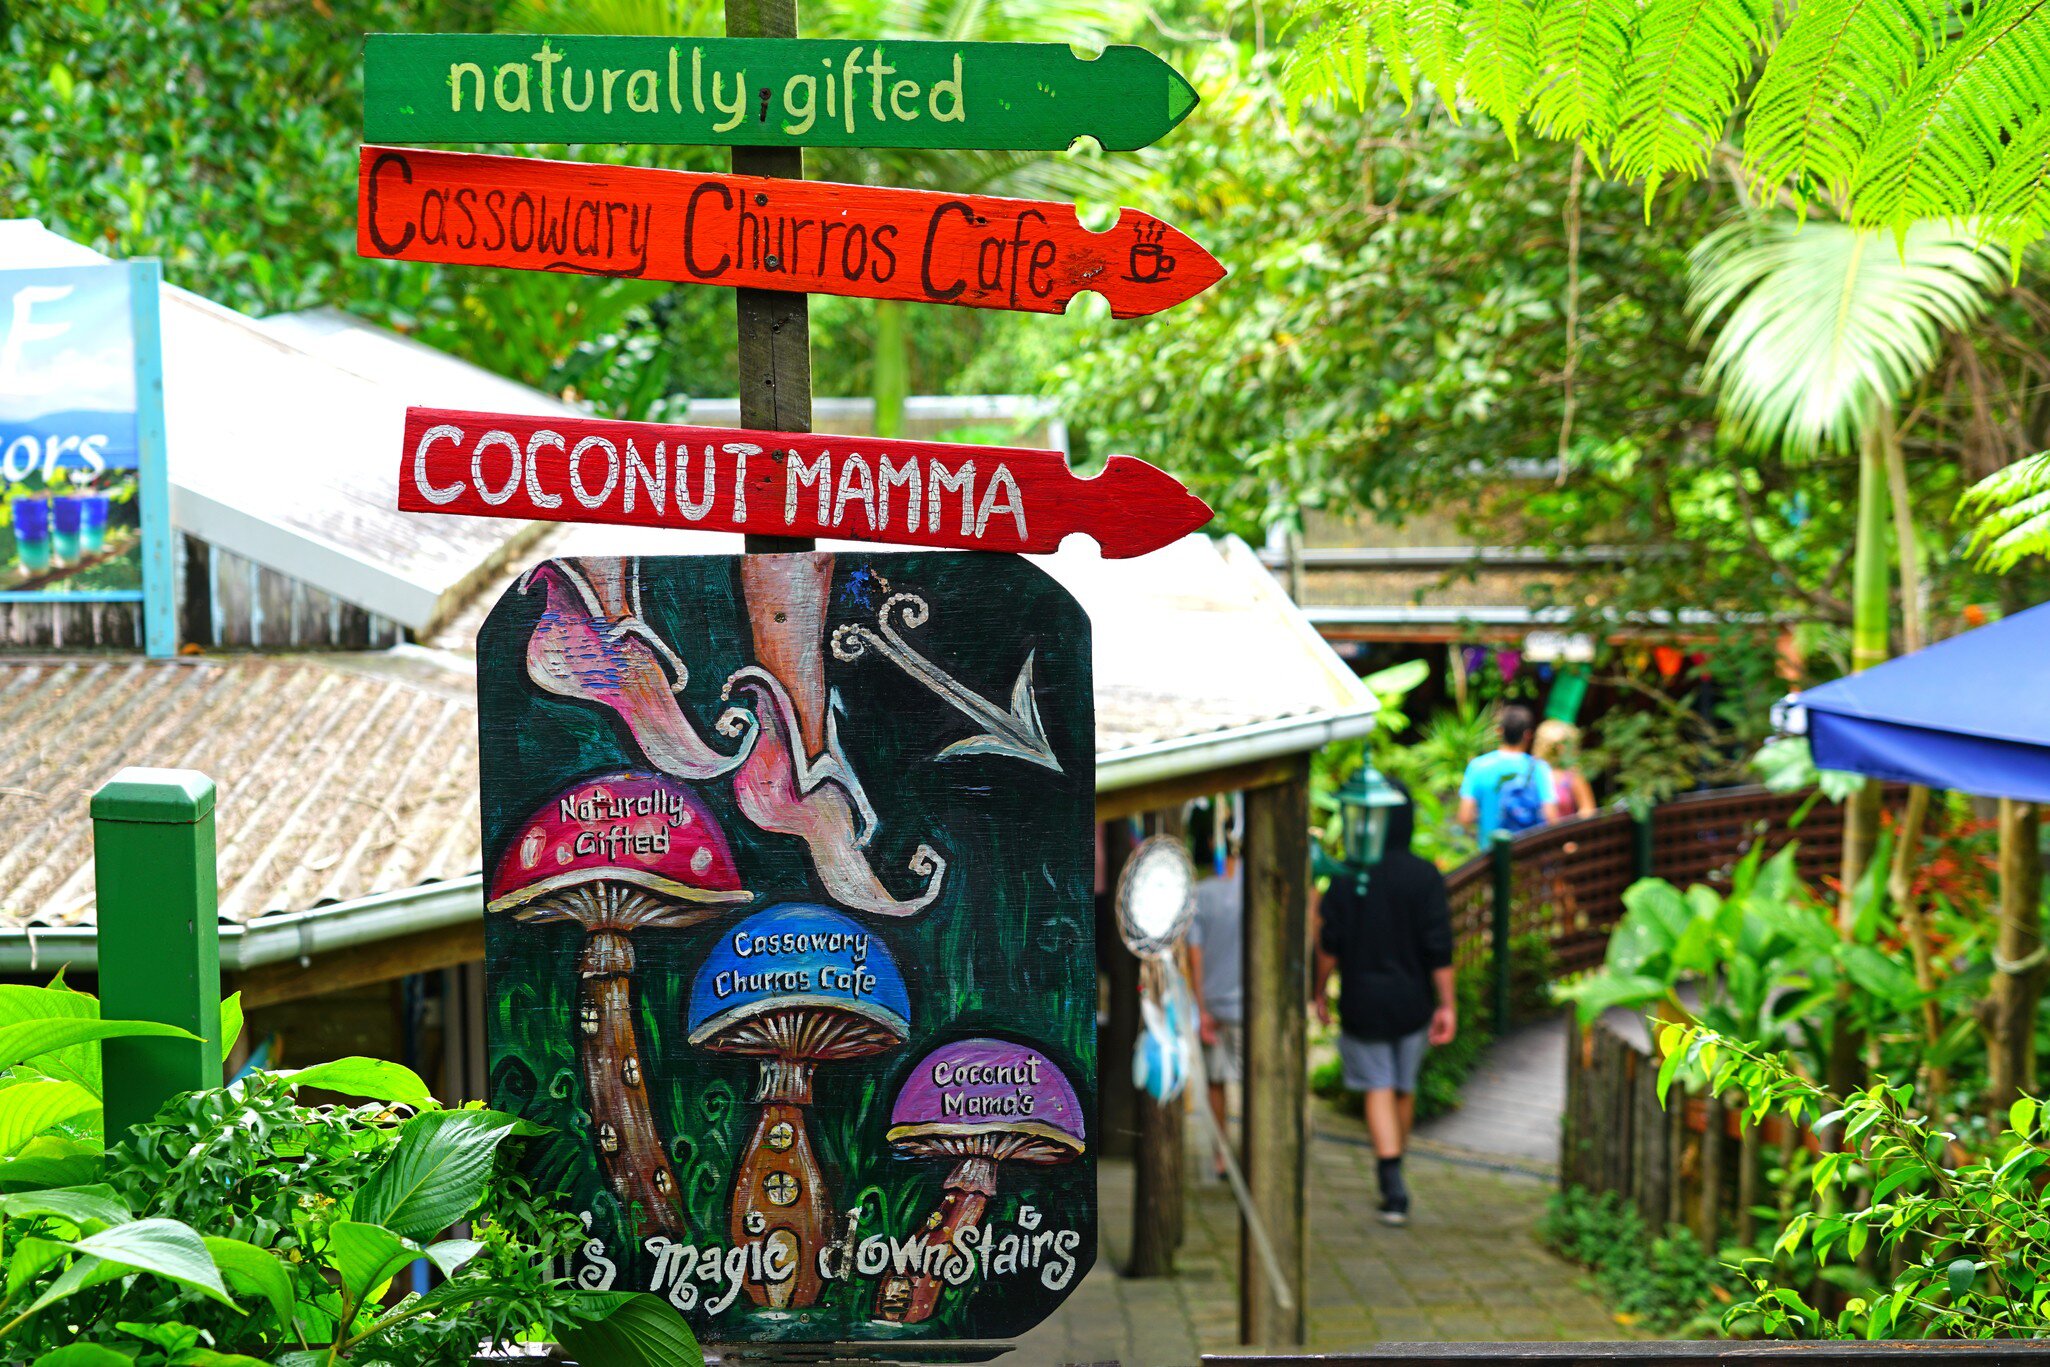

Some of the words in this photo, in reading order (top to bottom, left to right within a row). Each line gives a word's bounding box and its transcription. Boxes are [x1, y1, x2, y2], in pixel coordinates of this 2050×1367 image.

[449, 38, 747, 133] naturally
[782, 44, 966, 135] gifted
[367, 153, 650, 277] Cassowary
[684, 181, 898, 284] Churros
[922, 200, 1057, 309] Cafe
[0, 433, 109, 484] ors
[413, 424, 764, 524] COCONUT
[784, 448, 1029, 542] MAMMA
[561, 788, 685, 828] Naturally
[575, 825, 671, 860] Gifted
[734, 931, 869, 962] Cassowary
[714, 968, 811, 998] Churros
[820, 965, 877, 1000] Cafe
[933, 1055, 1042, 1086] Coconut
[944, 1088, 1035, 1116] Mama's
